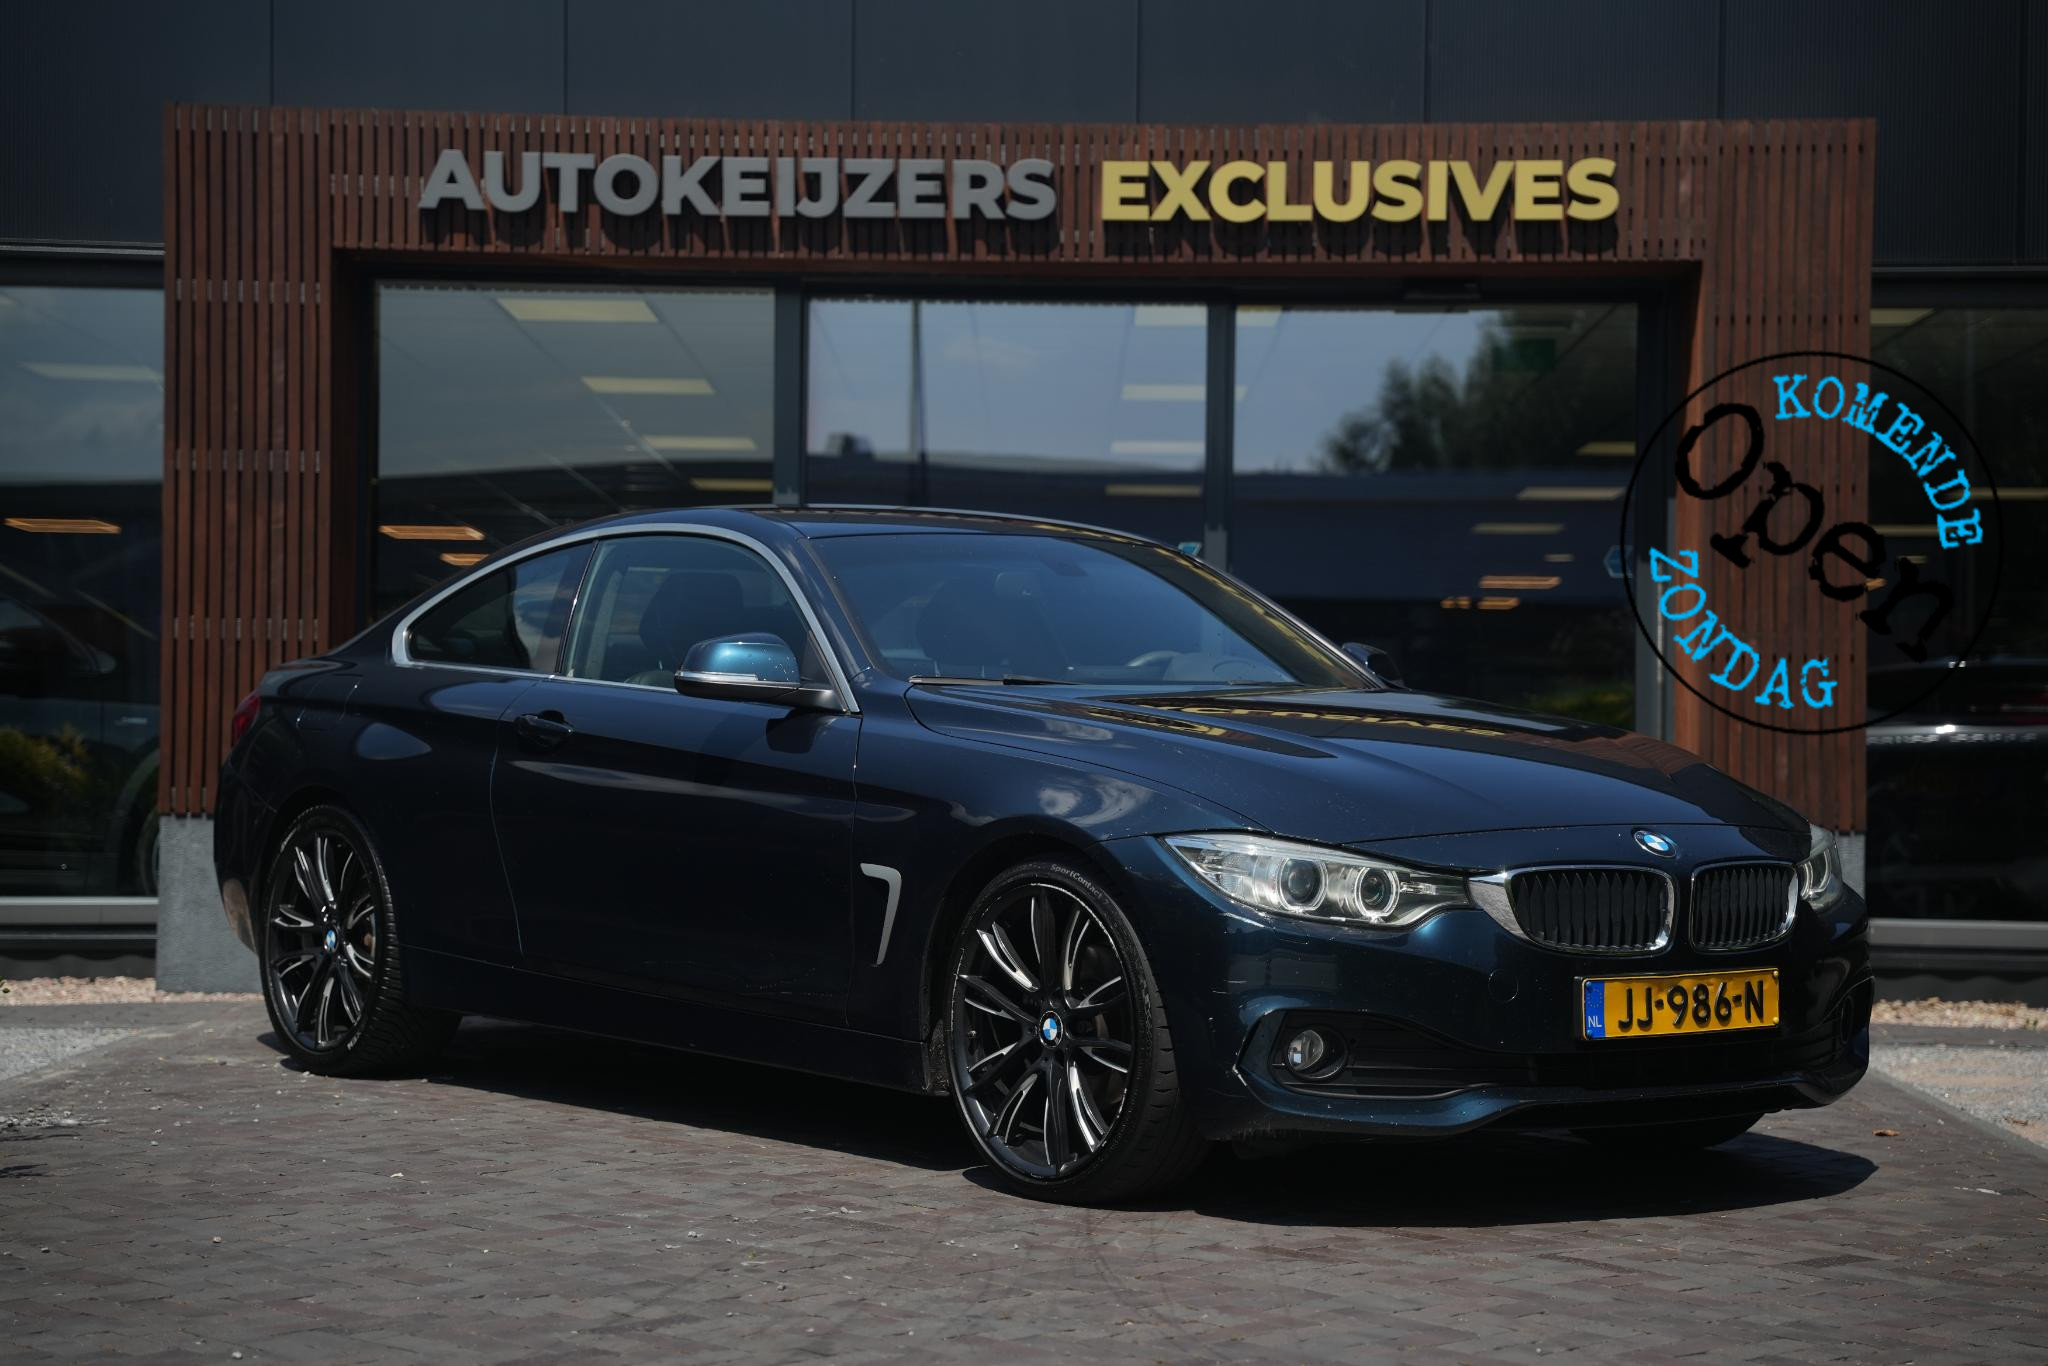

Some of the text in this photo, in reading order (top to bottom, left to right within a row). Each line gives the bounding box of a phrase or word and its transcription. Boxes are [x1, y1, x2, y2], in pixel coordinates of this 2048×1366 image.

[417, 148, 1620, 223] AUTOKEIJZERS EXCLUSIVES
[1588, 1015, 1602, 1028] NL
[1618, 980, 1764, 1032] JJ-986-N
